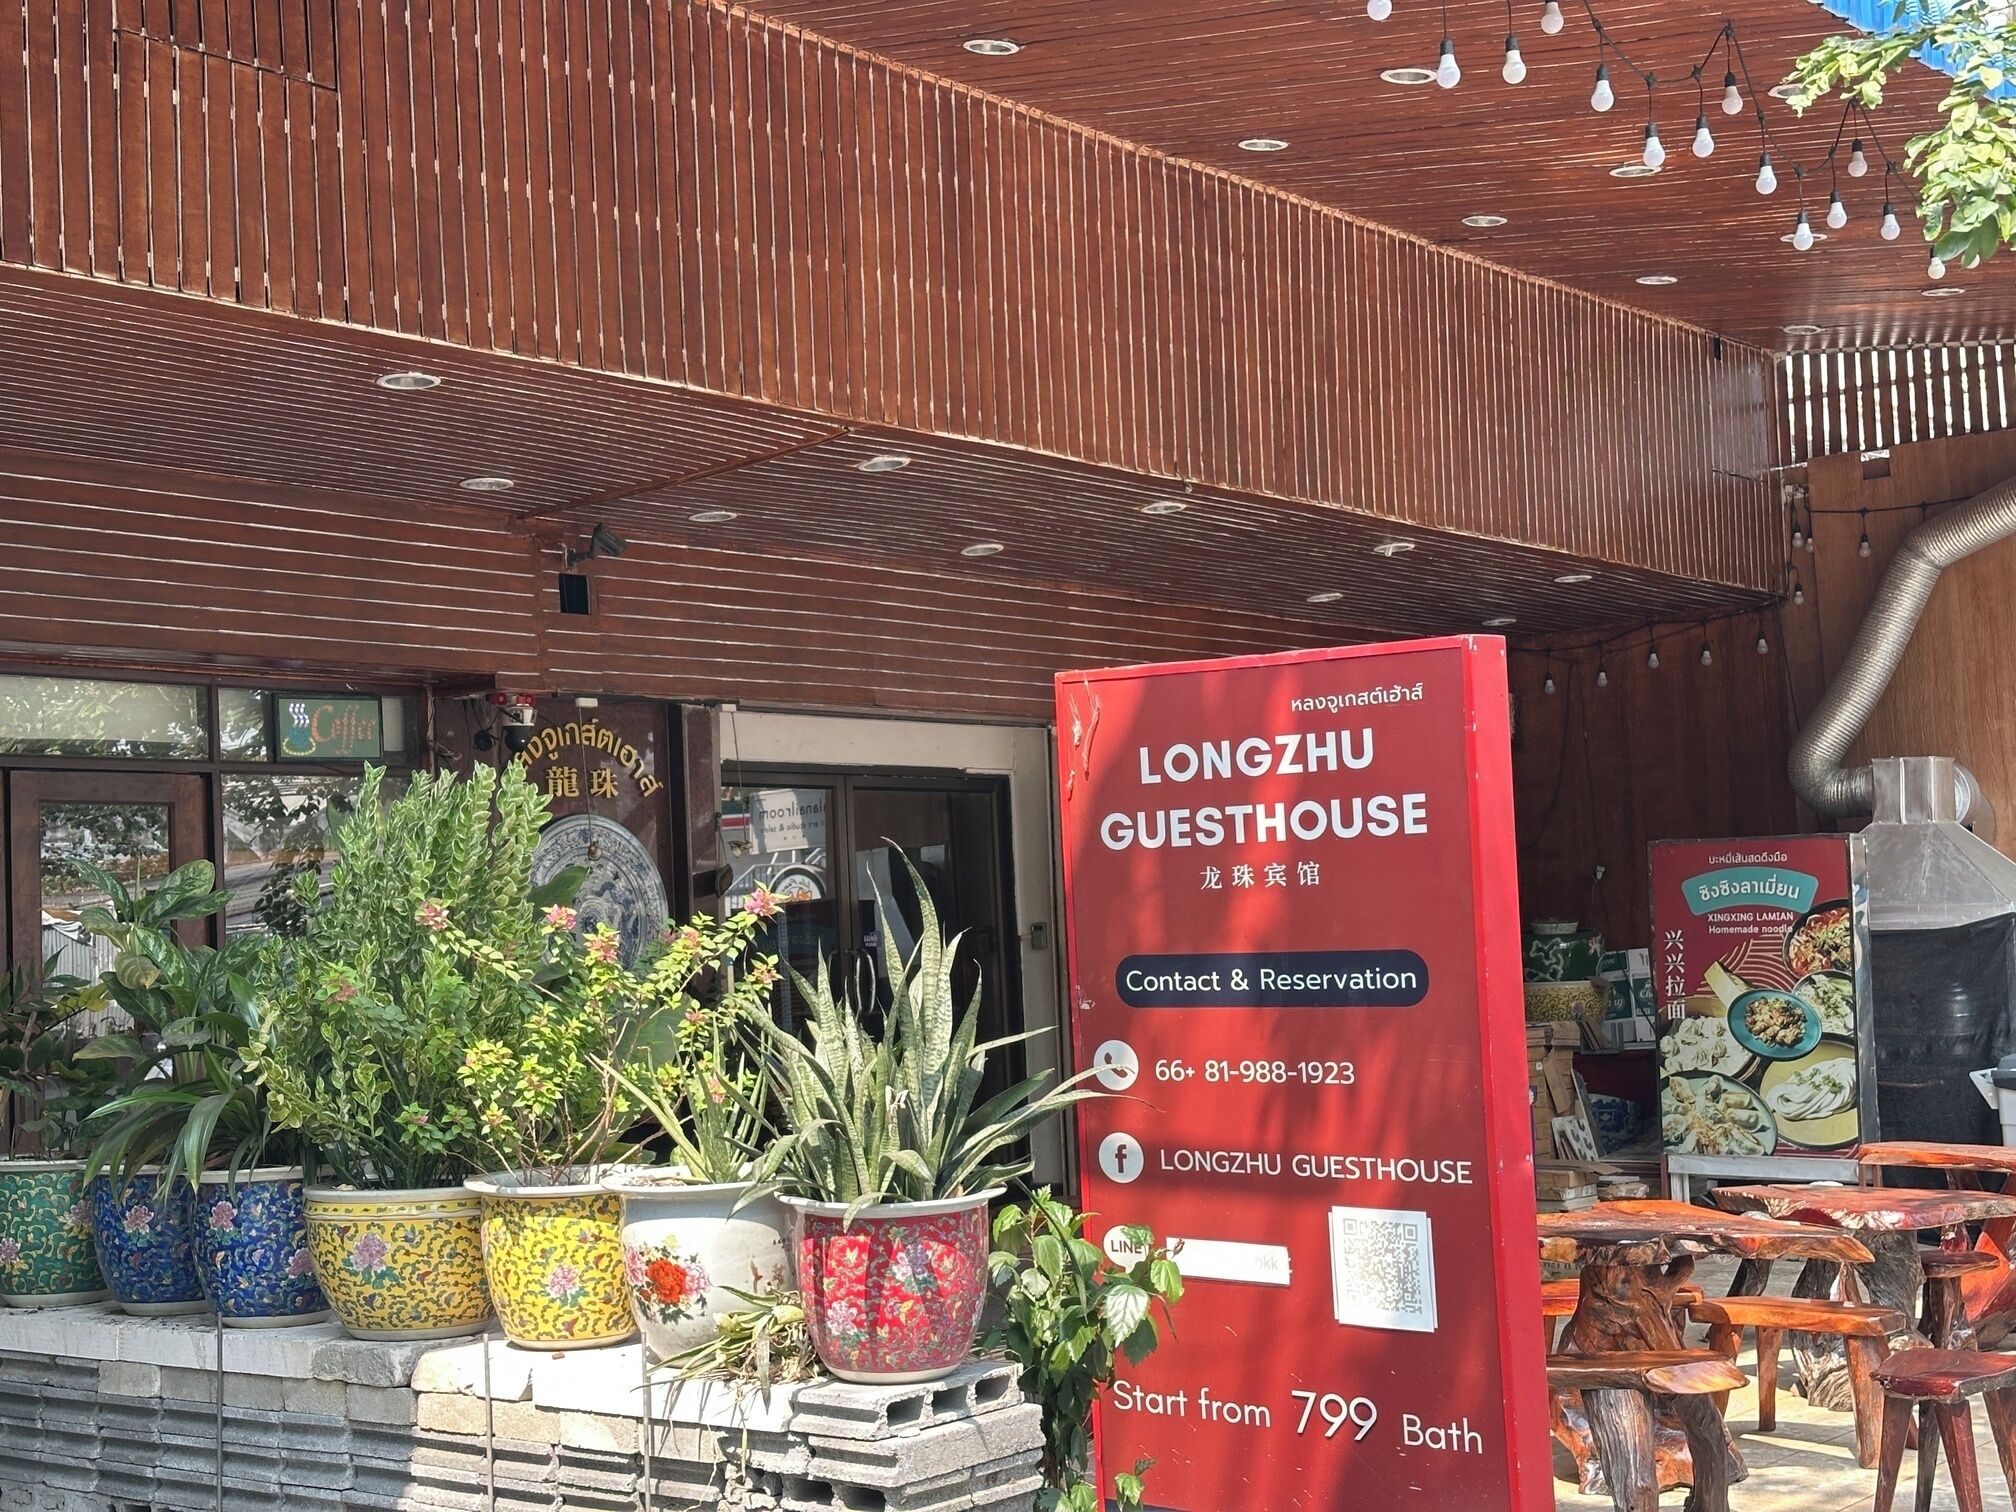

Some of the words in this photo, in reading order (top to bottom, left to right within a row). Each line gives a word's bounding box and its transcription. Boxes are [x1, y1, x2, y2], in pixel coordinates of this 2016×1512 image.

[1291, 682, 1424, 714] หลงจูเกสต์เฮ้าส์
[1139, 727, 1375, 785] LONGZHU
[546, 765, 619, 798] 龍珠
[1100, 793, 1428, 851] GUESTHOUSE
[1200, 861, 1321, 890] 龙珠宾馆
[1699, 873, 1800, 901] ซิงซิงลาเมี่ยน
[1707, 912, 1754, 922] XINGXING
[1756, 911, 1794, 921] LAMIAN
[1708, 925, 1759, 934] Homemade
[1761, 924, 1793, 934] noodle
[1126, 969, 1220, 992] Contact
[1231, 969, 1249, 991] &
[1260, 967, 1417, 991] Reservation
[1663, 929, 1687, 1021] 兴兴拉面
[1155, 1060, 1195, 1083] 66+
[1205, 1061, 1355, 1085] 81-988-1923
[1160, 1148, 1282, 1175] LONGZHU
[1292, 1154, 1473, 1185] GUESTHOUSE
[1110, 1239, 1142, 1254] LINE
[1113, 1379, 1187, 1417] Start
[1197, 1387, 1271, 1427] from
[1291, 1389, 1378, 1441] 799
[1402, 1412, 1483, 1455] Bath
